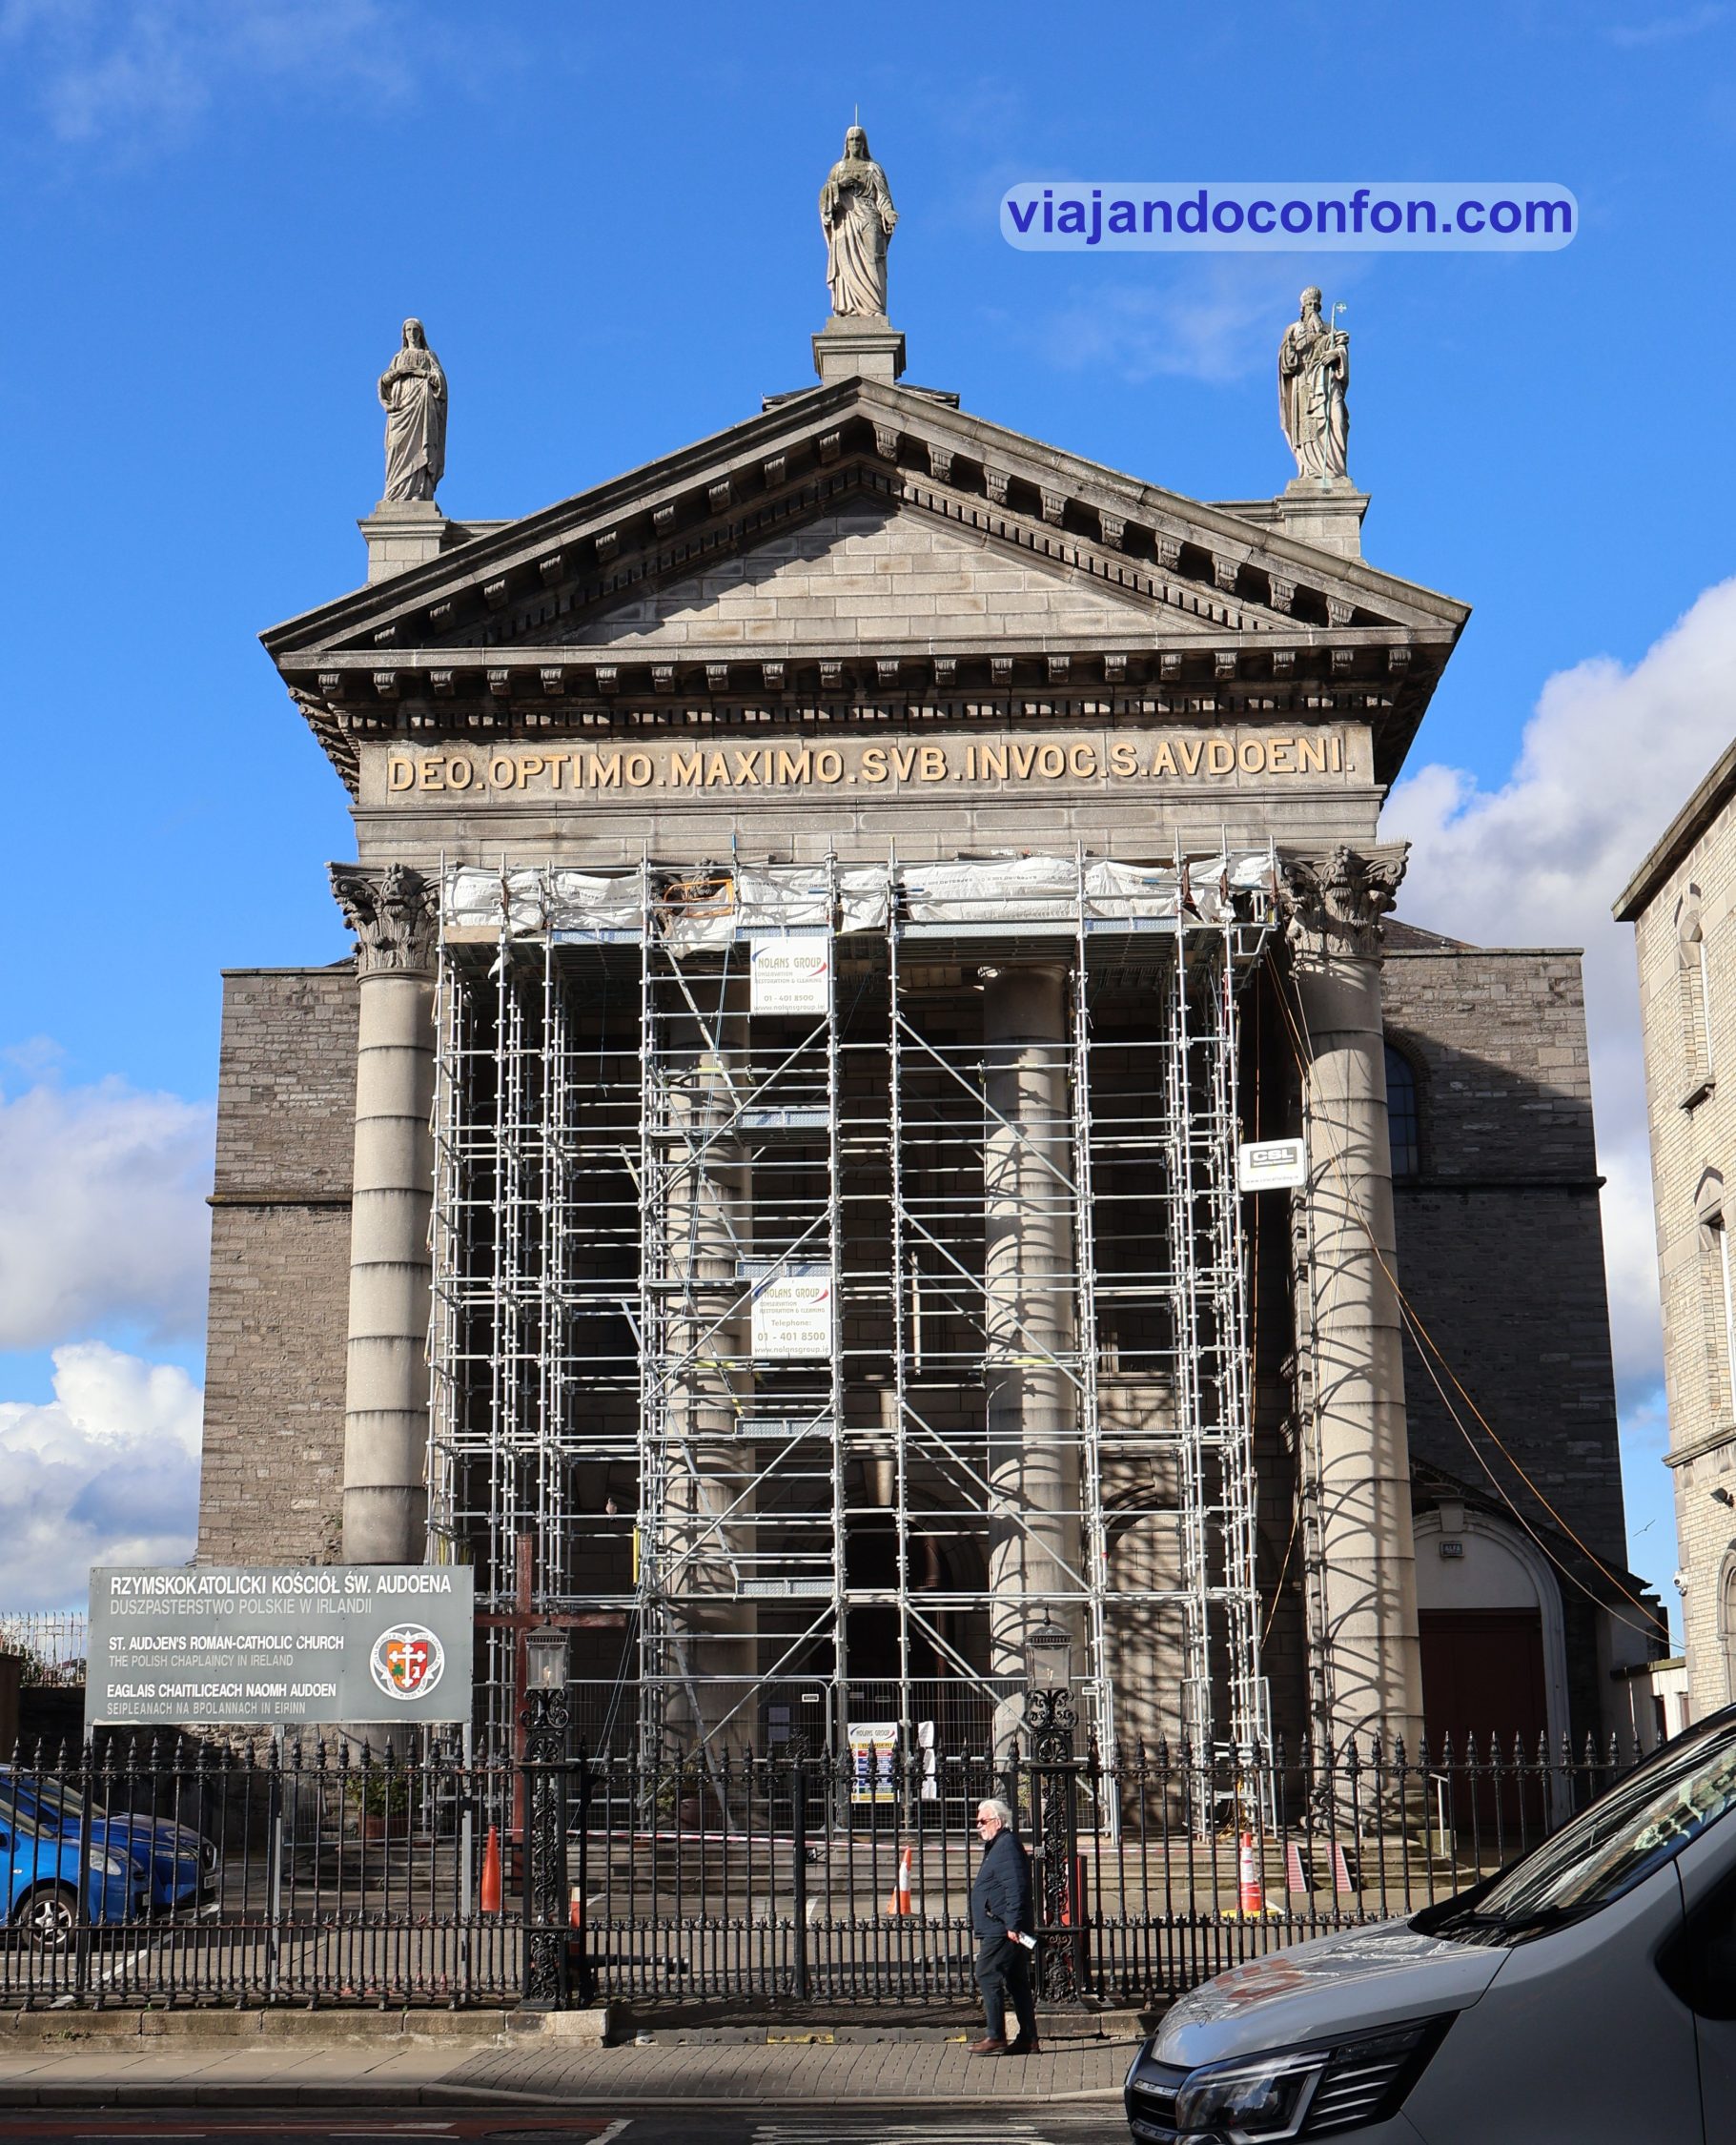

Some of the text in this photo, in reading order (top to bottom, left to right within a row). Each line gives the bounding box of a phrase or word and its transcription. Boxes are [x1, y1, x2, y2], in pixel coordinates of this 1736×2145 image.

[758, 956, 822, 969] NOLANS GROUP
[1253, 1149, 1295, 1162] CSL
[765, 1288, 820, 1298] NOLANS GROUP
[757, 1333, 768, 1341] 01
[801, 1332, 826, 1340] 8500
[754, 1345, 829, 1354] www.nolansgroup.ie
[111, 1571, 452, 1595] RZYMSKOKATOLICKI KOŚCIÓŁ ŚW. AUDOENA
[110, 1597, 372, 1615] DUSZPASTERSTWO POLSKIE W IRLANDII
[109, 1635, 344, 1651] ST. AUDOEN'S ROMAN-CATHOLIC CHURCH
[109, 1654, 294, 1667] THE POLISH CHAPLAINCY IN IRELAND
[107, 1683, 337, 1698] EAGLAIS CHAITILICEACH NAOMH AUDOEN
[107, 1701, 306, 1715] SEIPLEANACH NA BPOLANNACH IN EIRINN
